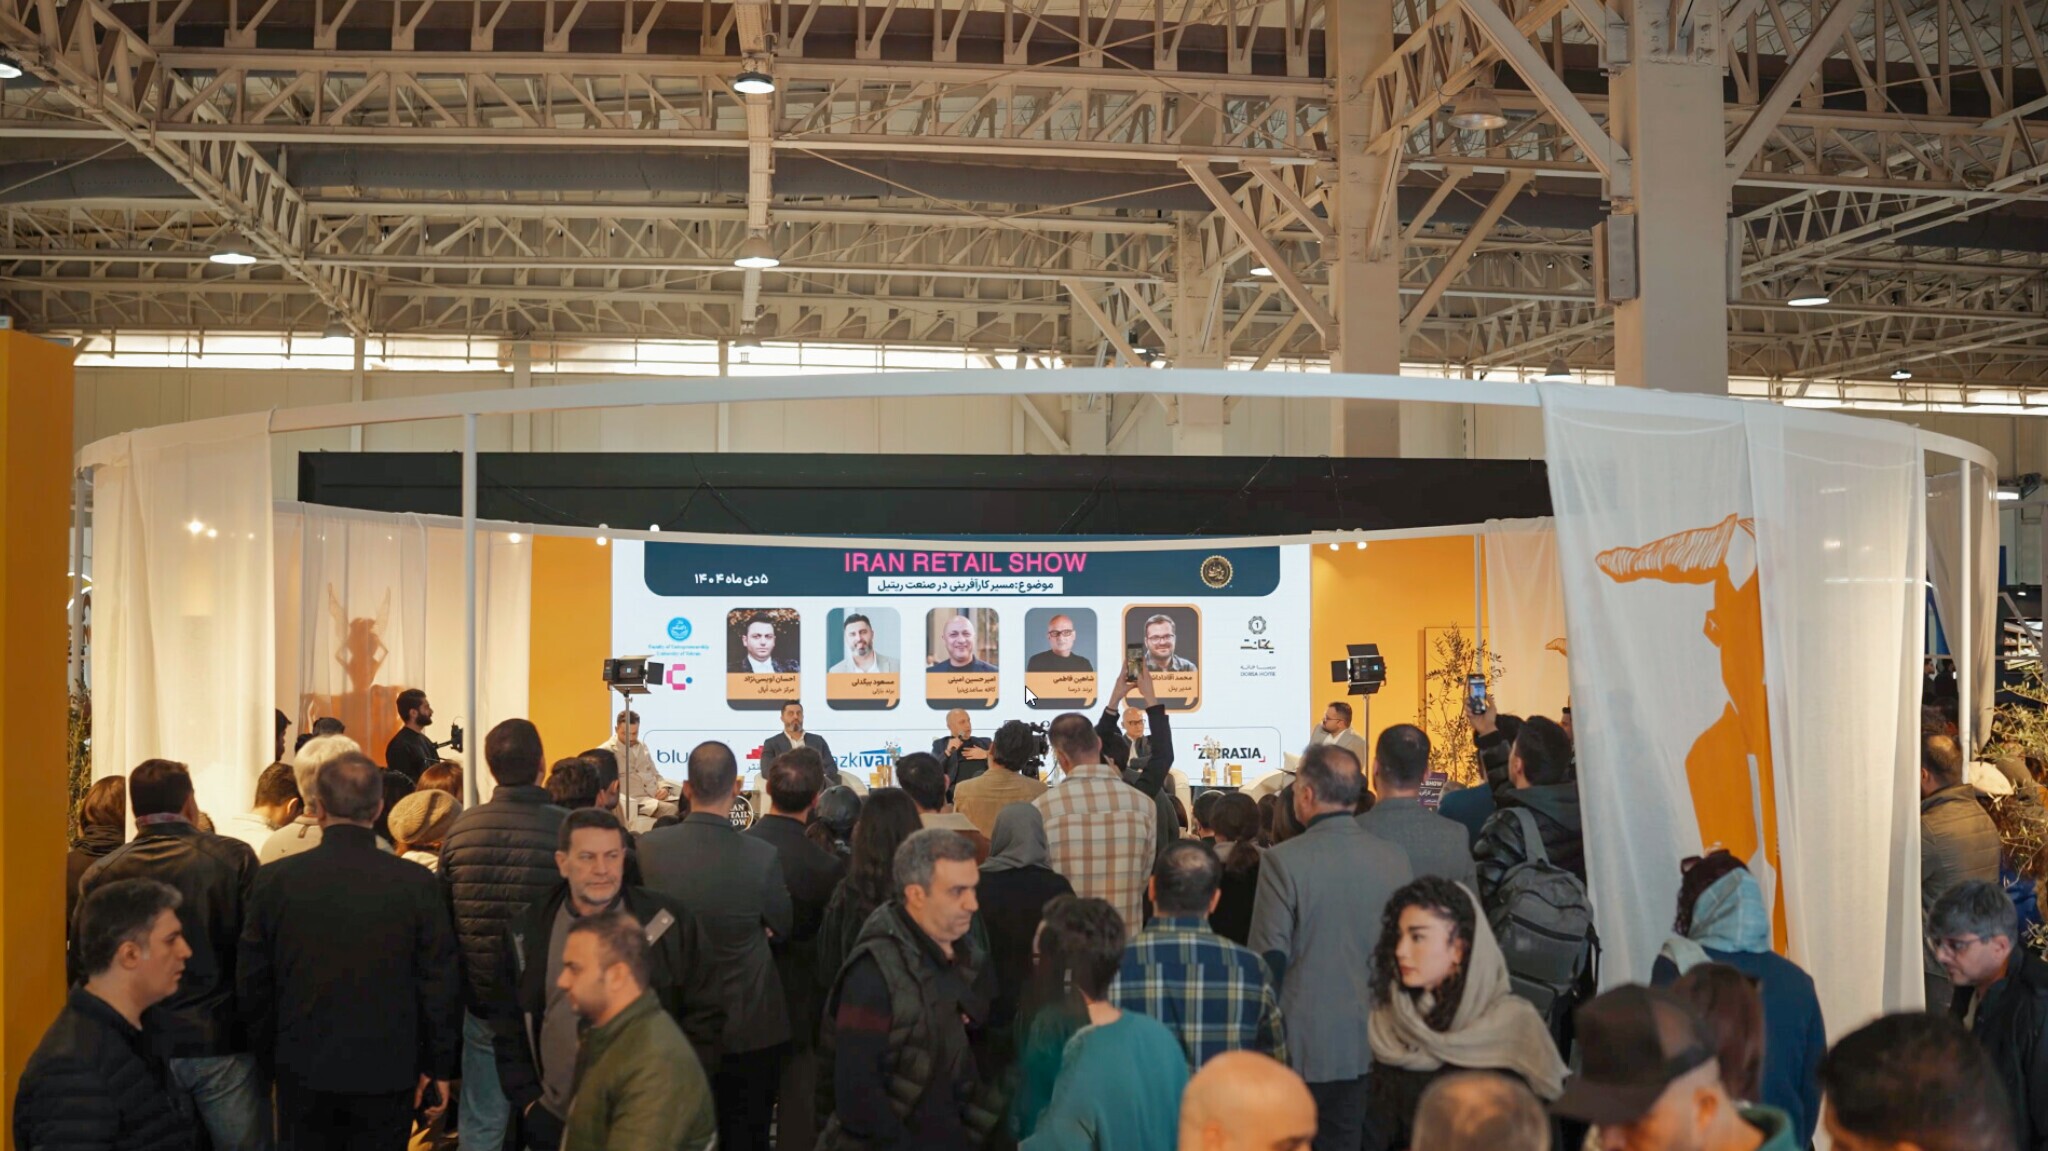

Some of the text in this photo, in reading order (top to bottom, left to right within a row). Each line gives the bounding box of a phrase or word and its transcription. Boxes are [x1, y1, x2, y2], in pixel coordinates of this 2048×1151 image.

[844, 552, 1087, 573] IRAN RETAIL SHOW
[877, 579, 904, 592] ریتیل
[905, 580, 937, 590] صنعت
[937, 581, 948, 592] در
[949, 578, 989, 593] کارآفرینی
[873, 679, 895, 687] مسعود
[1052, 675, 1095, 684] شاهین فاطمی
[657, 749, 689, 764] blu
